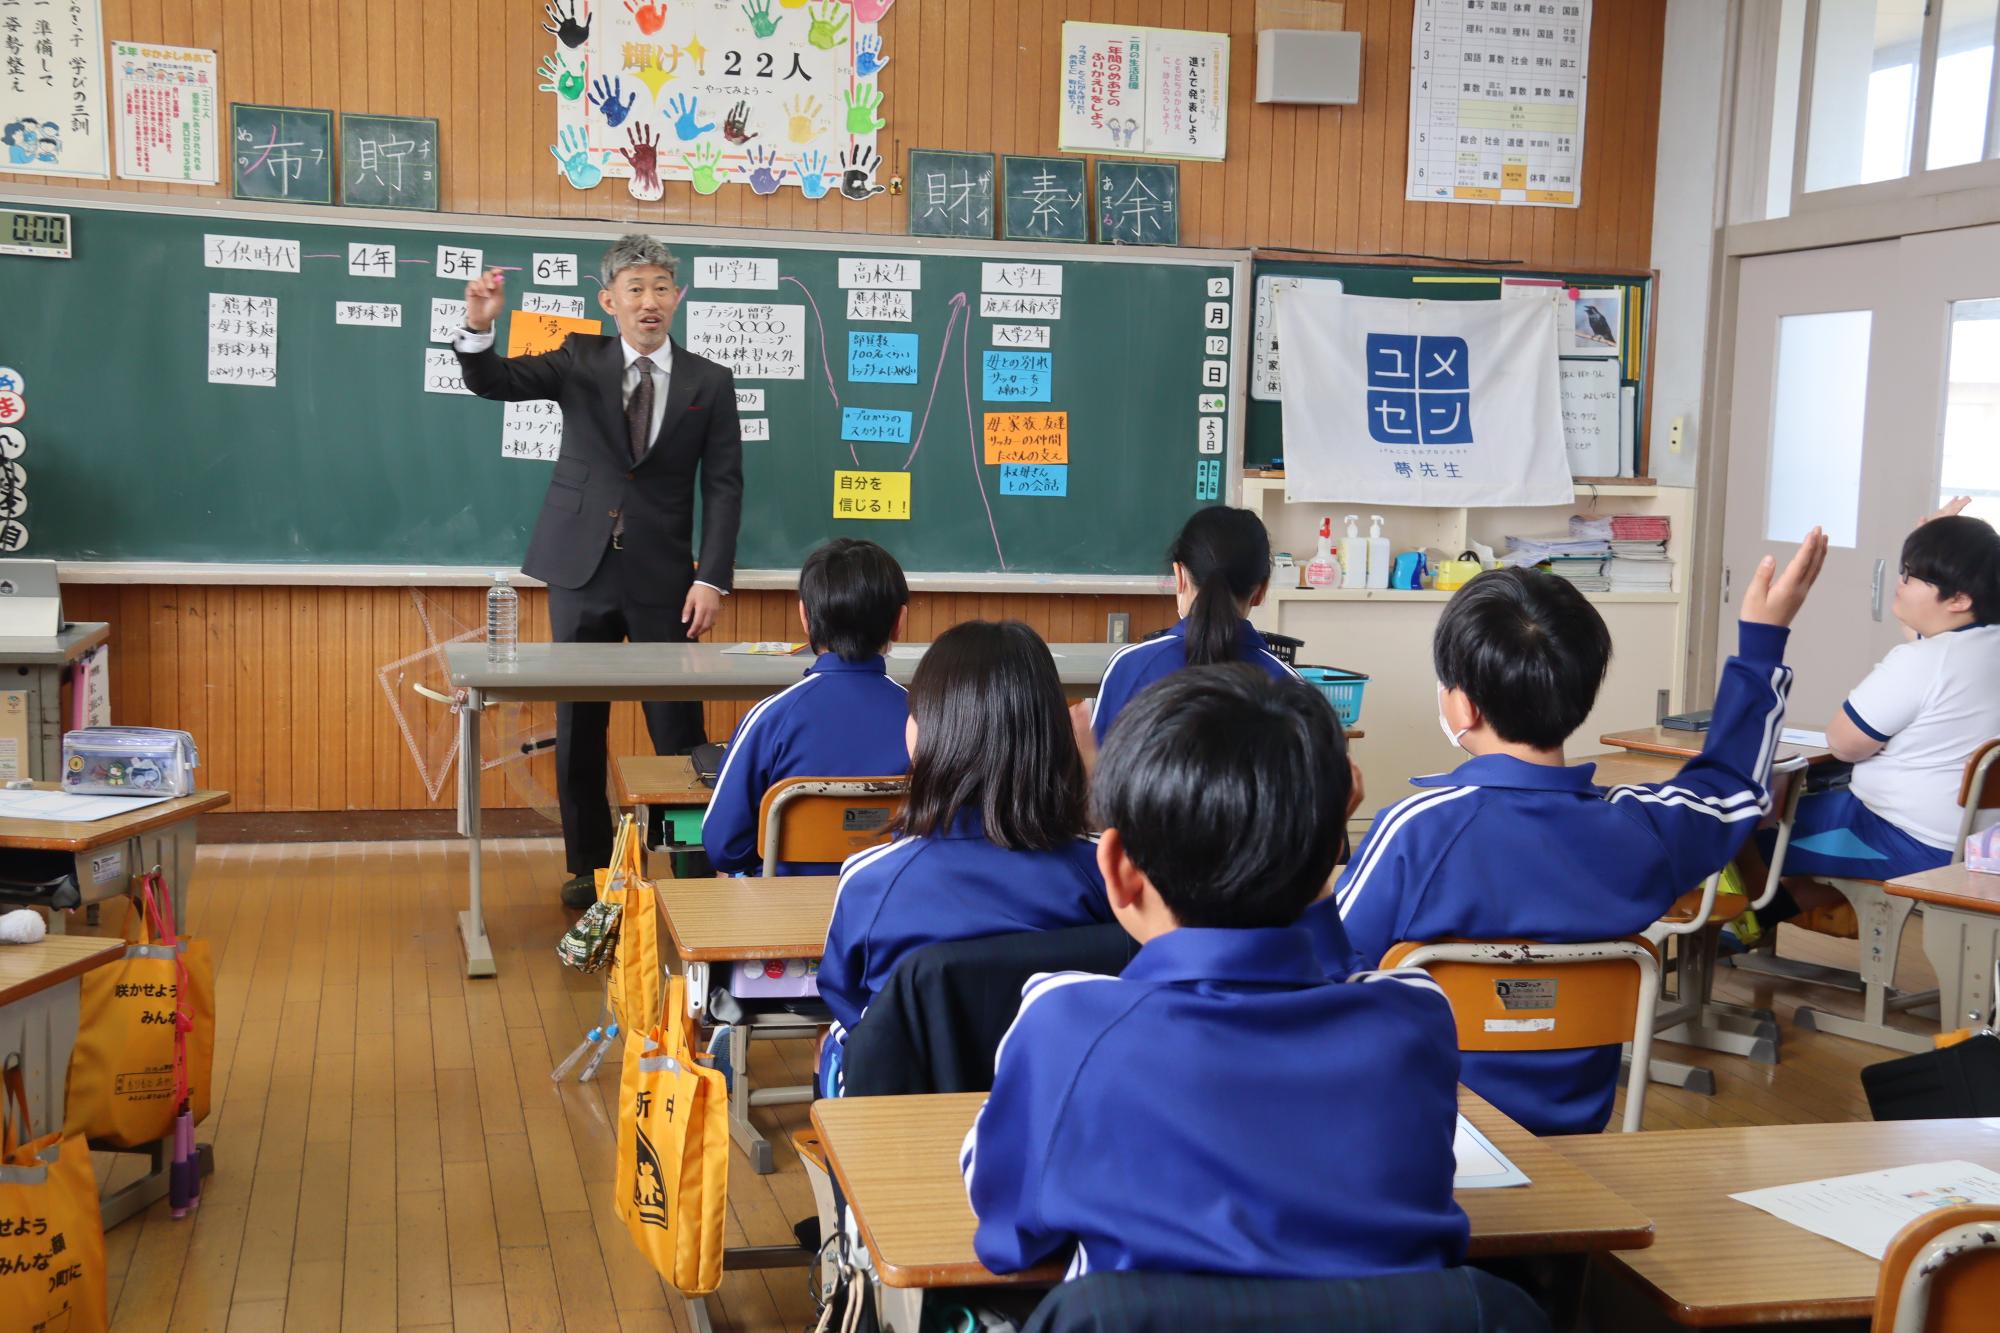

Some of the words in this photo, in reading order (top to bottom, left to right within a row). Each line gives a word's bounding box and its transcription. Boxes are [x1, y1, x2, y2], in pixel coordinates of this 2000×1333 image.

[1491, 1, 1507, 11] 国語
[1513, 4, 1531, 13] 体育
[1539, 5, 1555, 14] 総合
[1562, 6, 1579, 16] 国語
[1425, 22, 1431, 32] 2
[1466, 24, 1483, 33] 理科
[1512, 27, 1530, 37] 理科
[1537, 29, 1553, 39] 国語
[33, 19, 53, 87] 準備して
[1424, 51, 1430, 60] 3
[1464, 53, 1481, 62] 国語
[1488, 54, 1504, 64] 算数
[1511, 56, 1528, 65] 社会
[1536, 57, 1552, 66] 理科
[1128, 36, 1141, 90] 二月の生活目標
[1107, 40, 1123, 107] 一年間のめあての
[69, 57, 91, 136] 学びの三訓
[1091, 53, 1105, 129] ふりかえりをしよう
[1422, 81, 1427, 90] 4
[1463, 83, 1480, 92] 算数
[1510, 86, 1527, 96] 算数
[1534, 88, 1551, 97] 算数
[1559, 89, 1575, 99] 算数
[1188, 57, 1199, 144] 進んで発表しよう
[1419, 133, 1426, 143] 5
[1460, 136, 1477, 145] 総合
[1484, 136, 1500, 146] 社会
[243, 123, 304, 195] 布
[355, 134, 415, 191] 貯
[1418, 168, 1424, 177] 6
[1483, 171, 1499, 180] 音楽
[1530, 174, 1546, 183] 体育
[923, 170, 976, 224] 財
[1022, 169, 1068, 231] 素
[1114, 177, 1161, 236] 余
[13, 214, 64, 243] 0:00
[351, 248, 394, 274] 4年
[443, 251, 477, 276] 5年
[537, 257, 571, 280] 6年
[708, 260, 767, 283] 中学生
[853, 262, 912, 283] 高校生
[997, 267, 1051, 288] 大学生
[1214, 282, 1223, 294] 2
[855, 291, 902, 305] 熊本県立
[221, 296, 275, 319] 熊本県
[347, 305, 399, 323] 野球部
[702, 305, 774, 320] ブラジル留学
[850, 305, 909, 320] 大津高校
[1210, 308, 1223, 324] 月
[216, 319, 275, 338] 母子家庭
[997, 326, 1047, 344] 大学2年
[702, 332, 792, 346] 毎日のトレーニング
[1210, 339, 1225, 352] 12
[216, 343, 273, 359] 野球少年
[702, 347, 795, 362] 全体練習以外
[986, 353, 1049, 370] 母との別れ
[1374, 348, 1458, 379] ユメ
[1208, 367, 1221, 383] 日
[1202, 399, 1213, 409] 木
[1373, 399, 1462, 436] セン
[851, 426, 905, 438] スカウトなし
[990, 434, 1062, 446] サッカーの仲間
[1206, 420, 1216, 451] よう日
[997, 448, 1062, 463] たくさんの支え
[1393, 461, 1465, 479] 夢先生
[840, 475, 882, 491] 自分を
[115, 984, 178, 998] 咲かせよう
